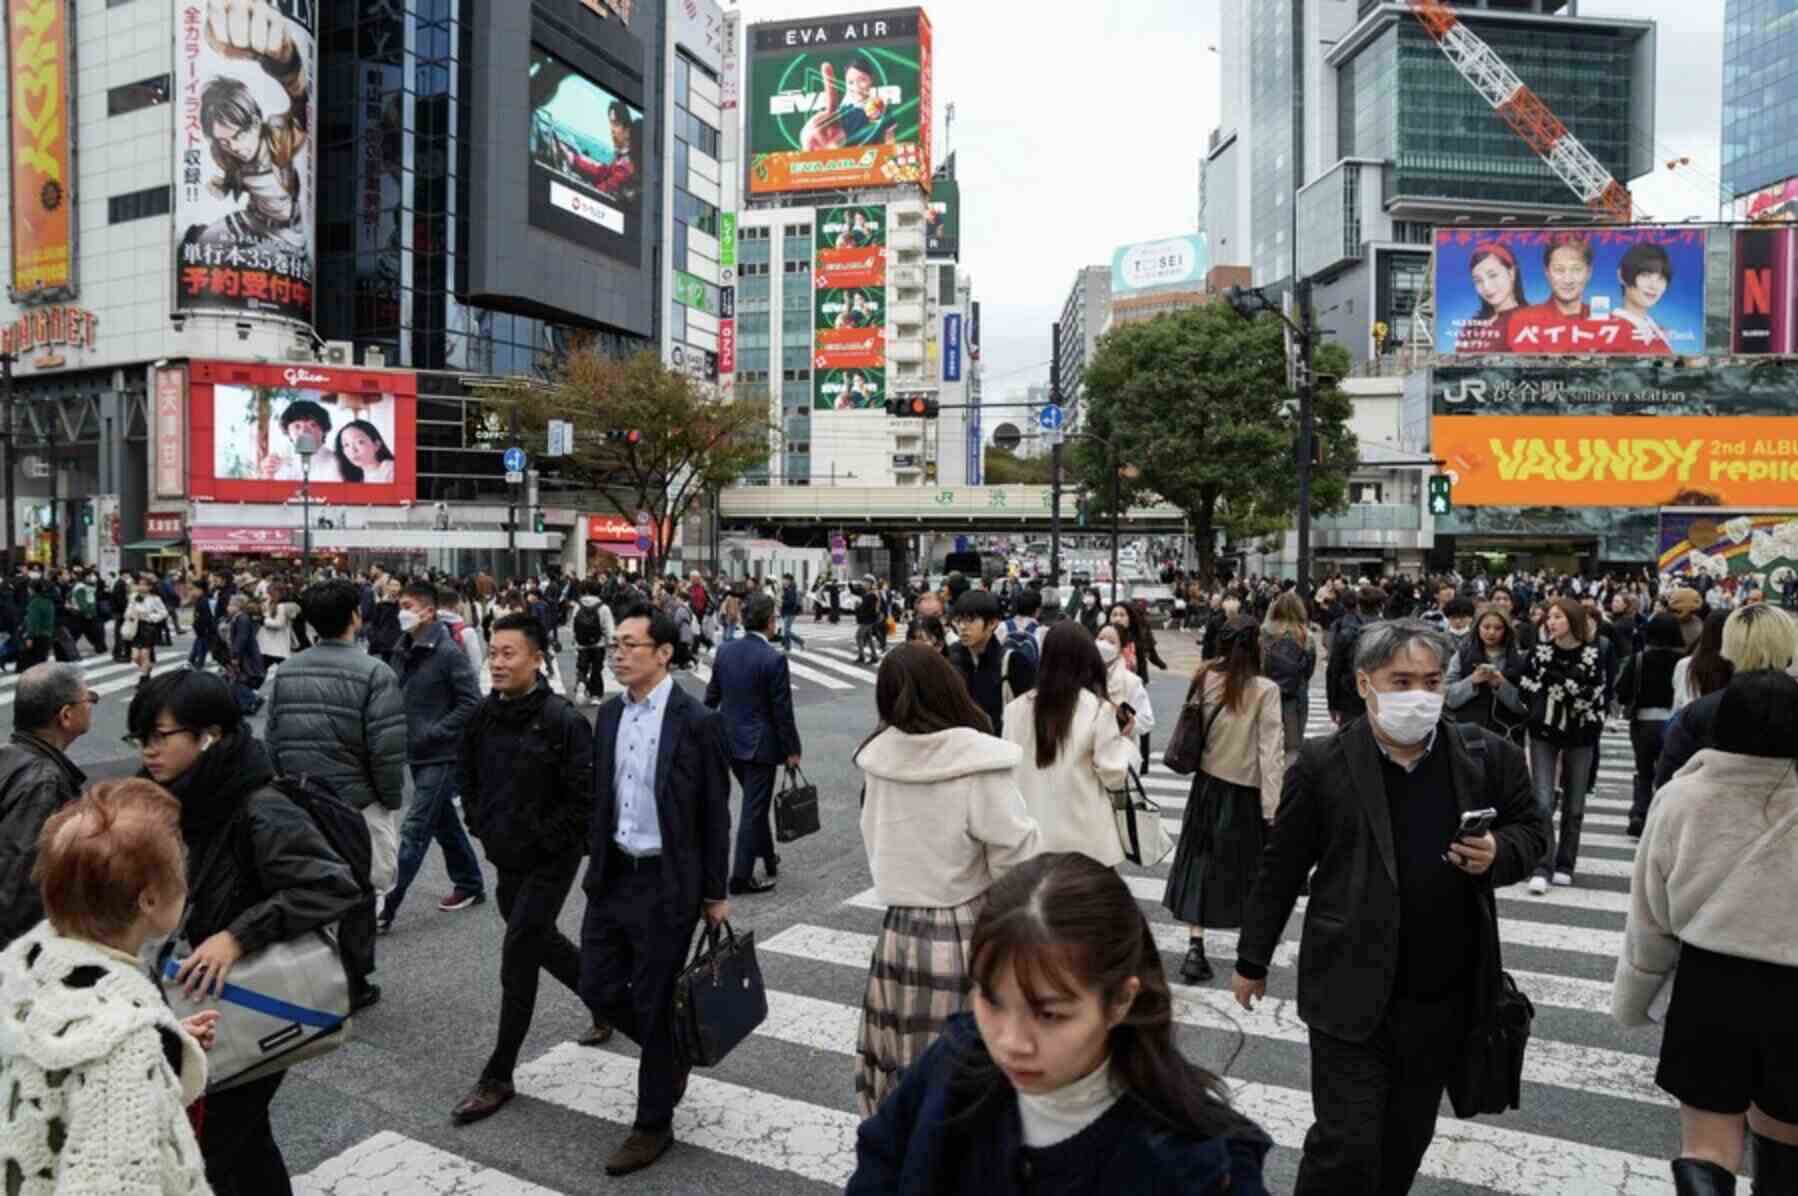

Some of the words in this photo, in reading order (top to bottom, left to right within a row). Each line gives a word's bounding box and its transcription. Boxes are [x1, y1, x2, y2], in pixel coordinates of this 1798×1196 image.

[785, 27, 827, 45] EVA
[844, 21, 888, 39] AIR
[1743, 269, 1772, 314] N
[283, 368, 330, 385] Glico
[1443, 378, 1487, 403] JR
[1492, 380, 1568, 403] 渋谷駅
[1711, 439, 1745, 455] 2nd
[1488, 438, 1704, 481] VAUNDY
